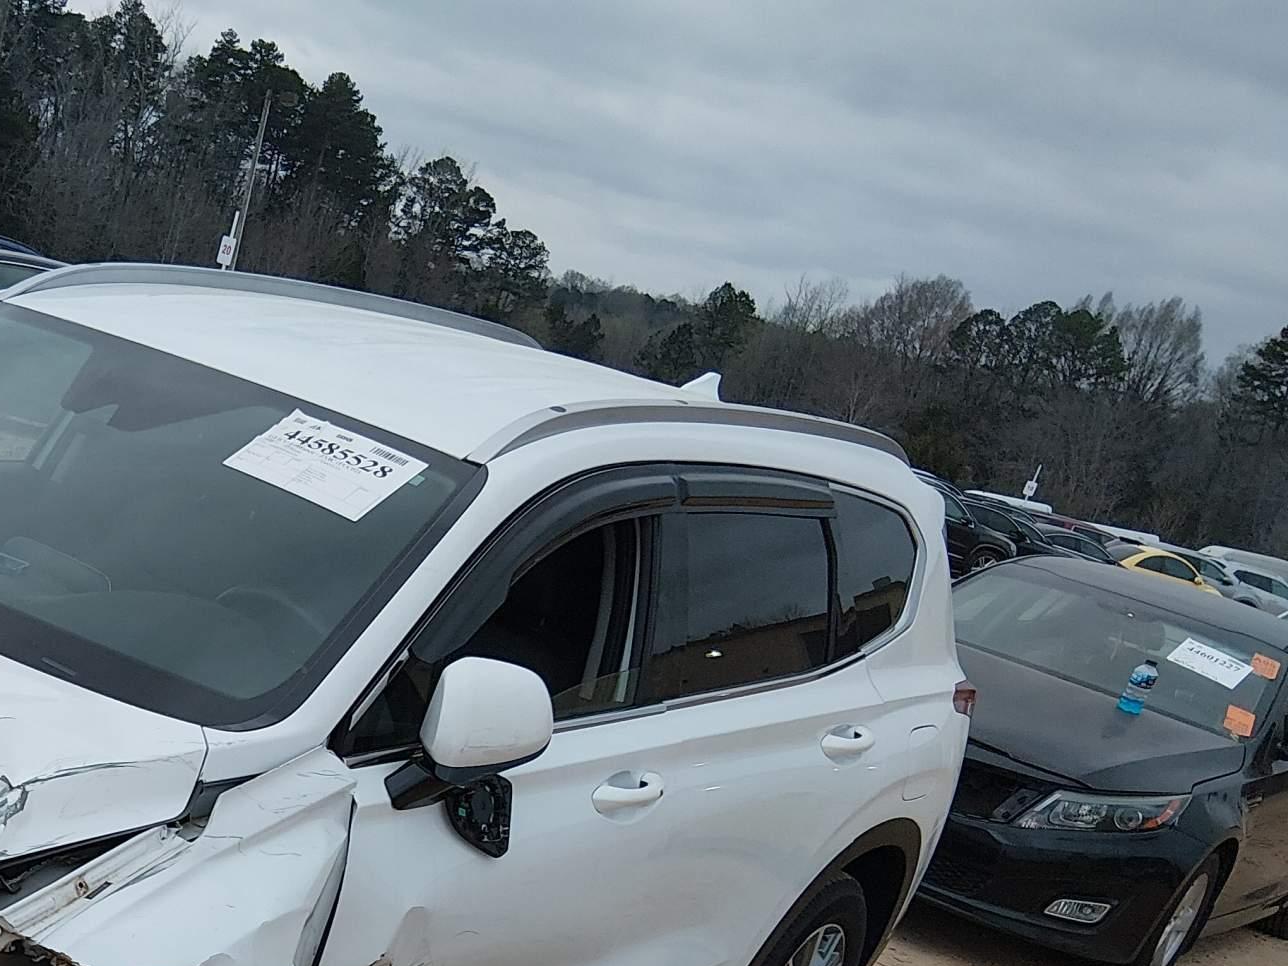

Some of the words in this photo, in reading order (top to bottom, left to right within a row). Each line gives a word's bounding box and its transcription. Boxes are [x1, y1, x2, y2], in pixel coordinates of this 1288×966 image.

[222, 244, 232, 256] 20
[283, 430, 394, 479] 44585528
[1186, 646, 1241, 672] 44601227
